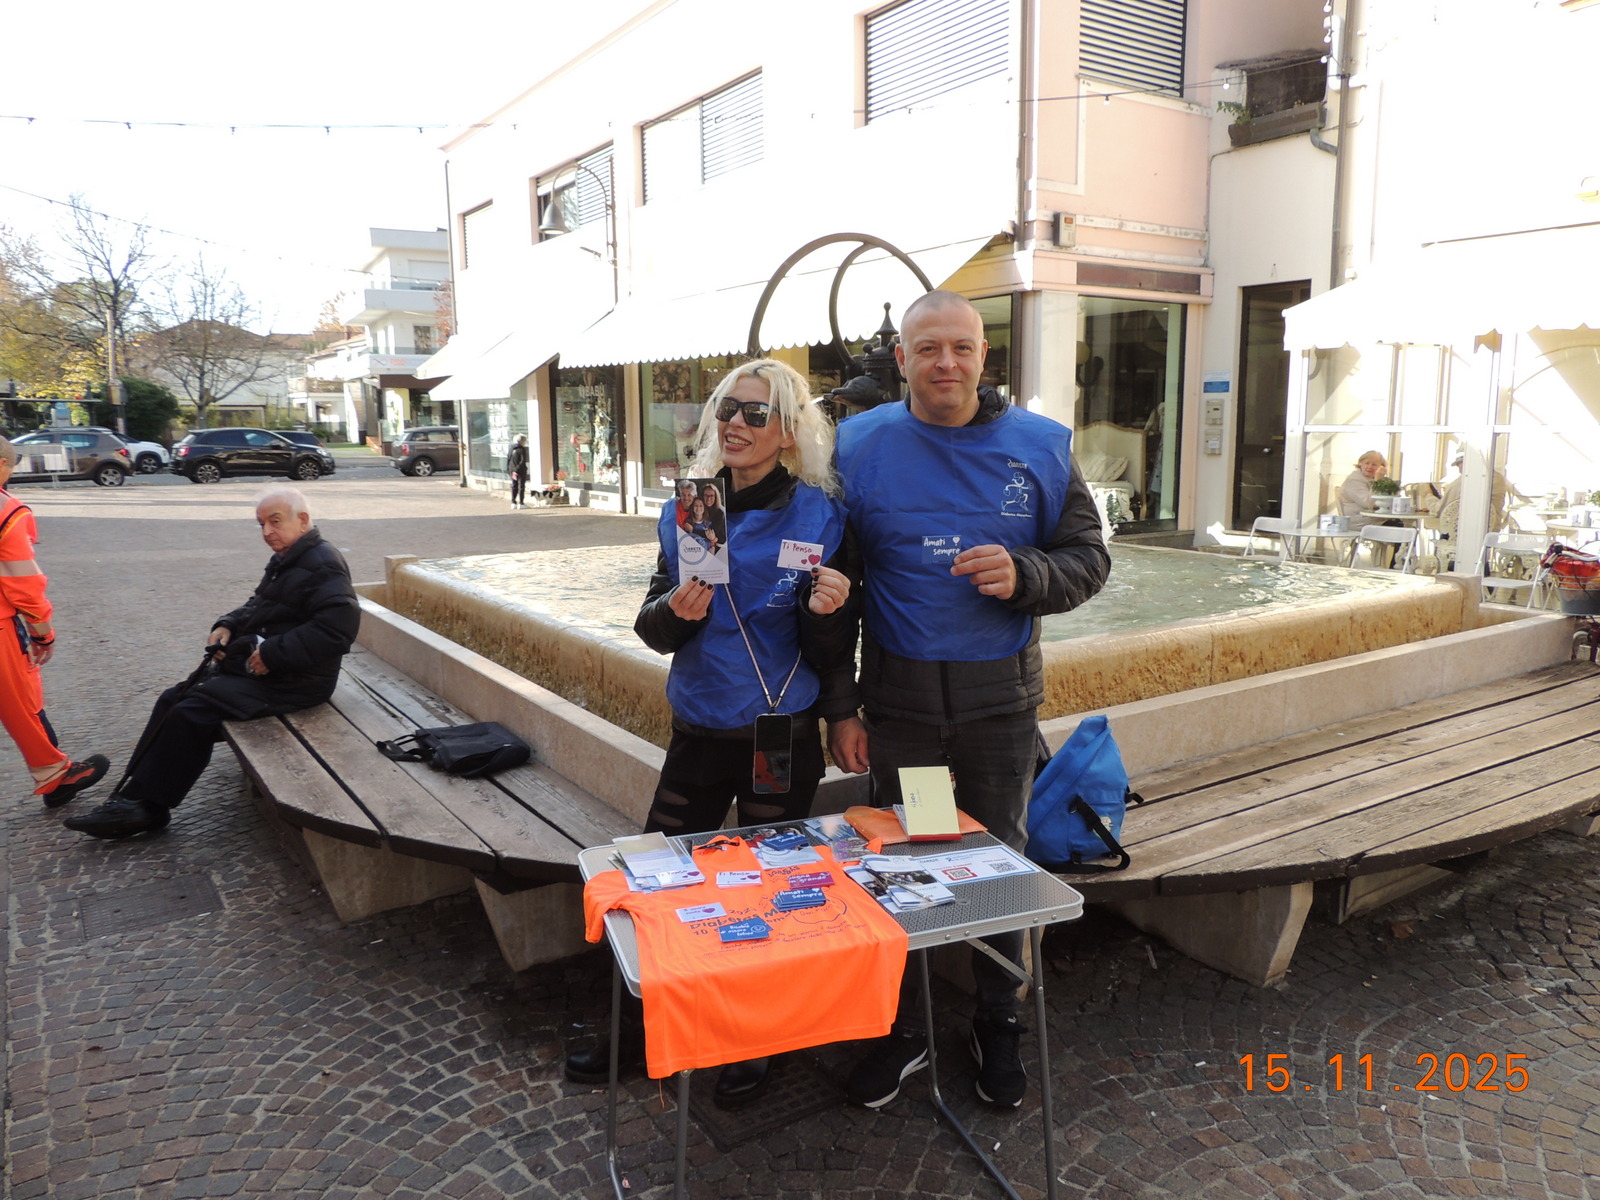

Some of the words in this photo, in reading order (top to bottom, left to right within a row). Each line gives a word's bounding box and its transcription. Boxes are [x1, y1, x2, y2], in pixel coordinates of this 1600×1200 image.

[923, 537, 946, 547] Amati
[782, 541, 790, 550] Ti
[792, 542, 813, 554] Penso
[933, 547, 961, 557] sempre
